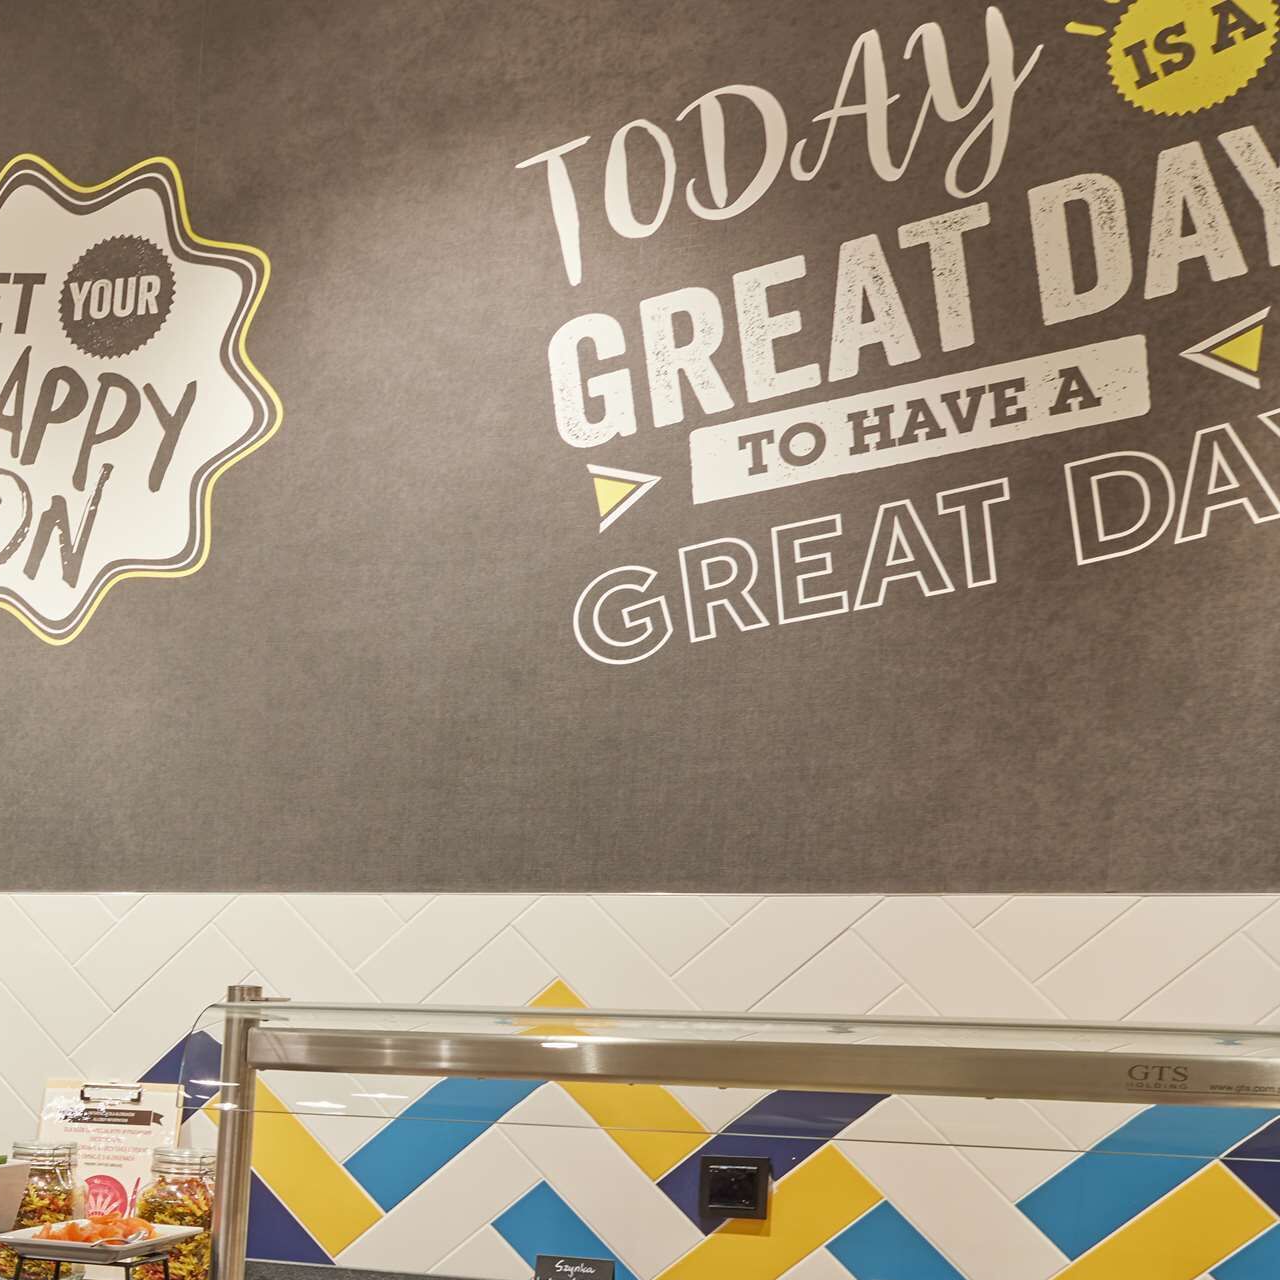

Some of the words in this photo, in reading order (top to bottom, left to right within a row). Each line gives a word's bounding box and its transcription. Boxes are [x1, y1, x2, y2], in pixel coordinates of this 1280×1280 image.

[1122, 24, 1196, 90] IS
[1211, 0, 1266, 51] A
[515, 5, 1044, 286] TODAY
[71, 274, 160, 321] YOUR
[547, 202, 991, 449] GREAT
[738, 422, 826, 478] TO
[847, 376, 1030, 458] HAVE
[1048, 366, 1103, 416] A
[572, 478, 1010, 665] GREAT
[1064, 405, 1280, 567] DA
[1126, 1082, 1188, 1090] HOLDING
[1128, 1064, 1188, 1082] GTS
[554, 1260, 596, 1277] Szynka
